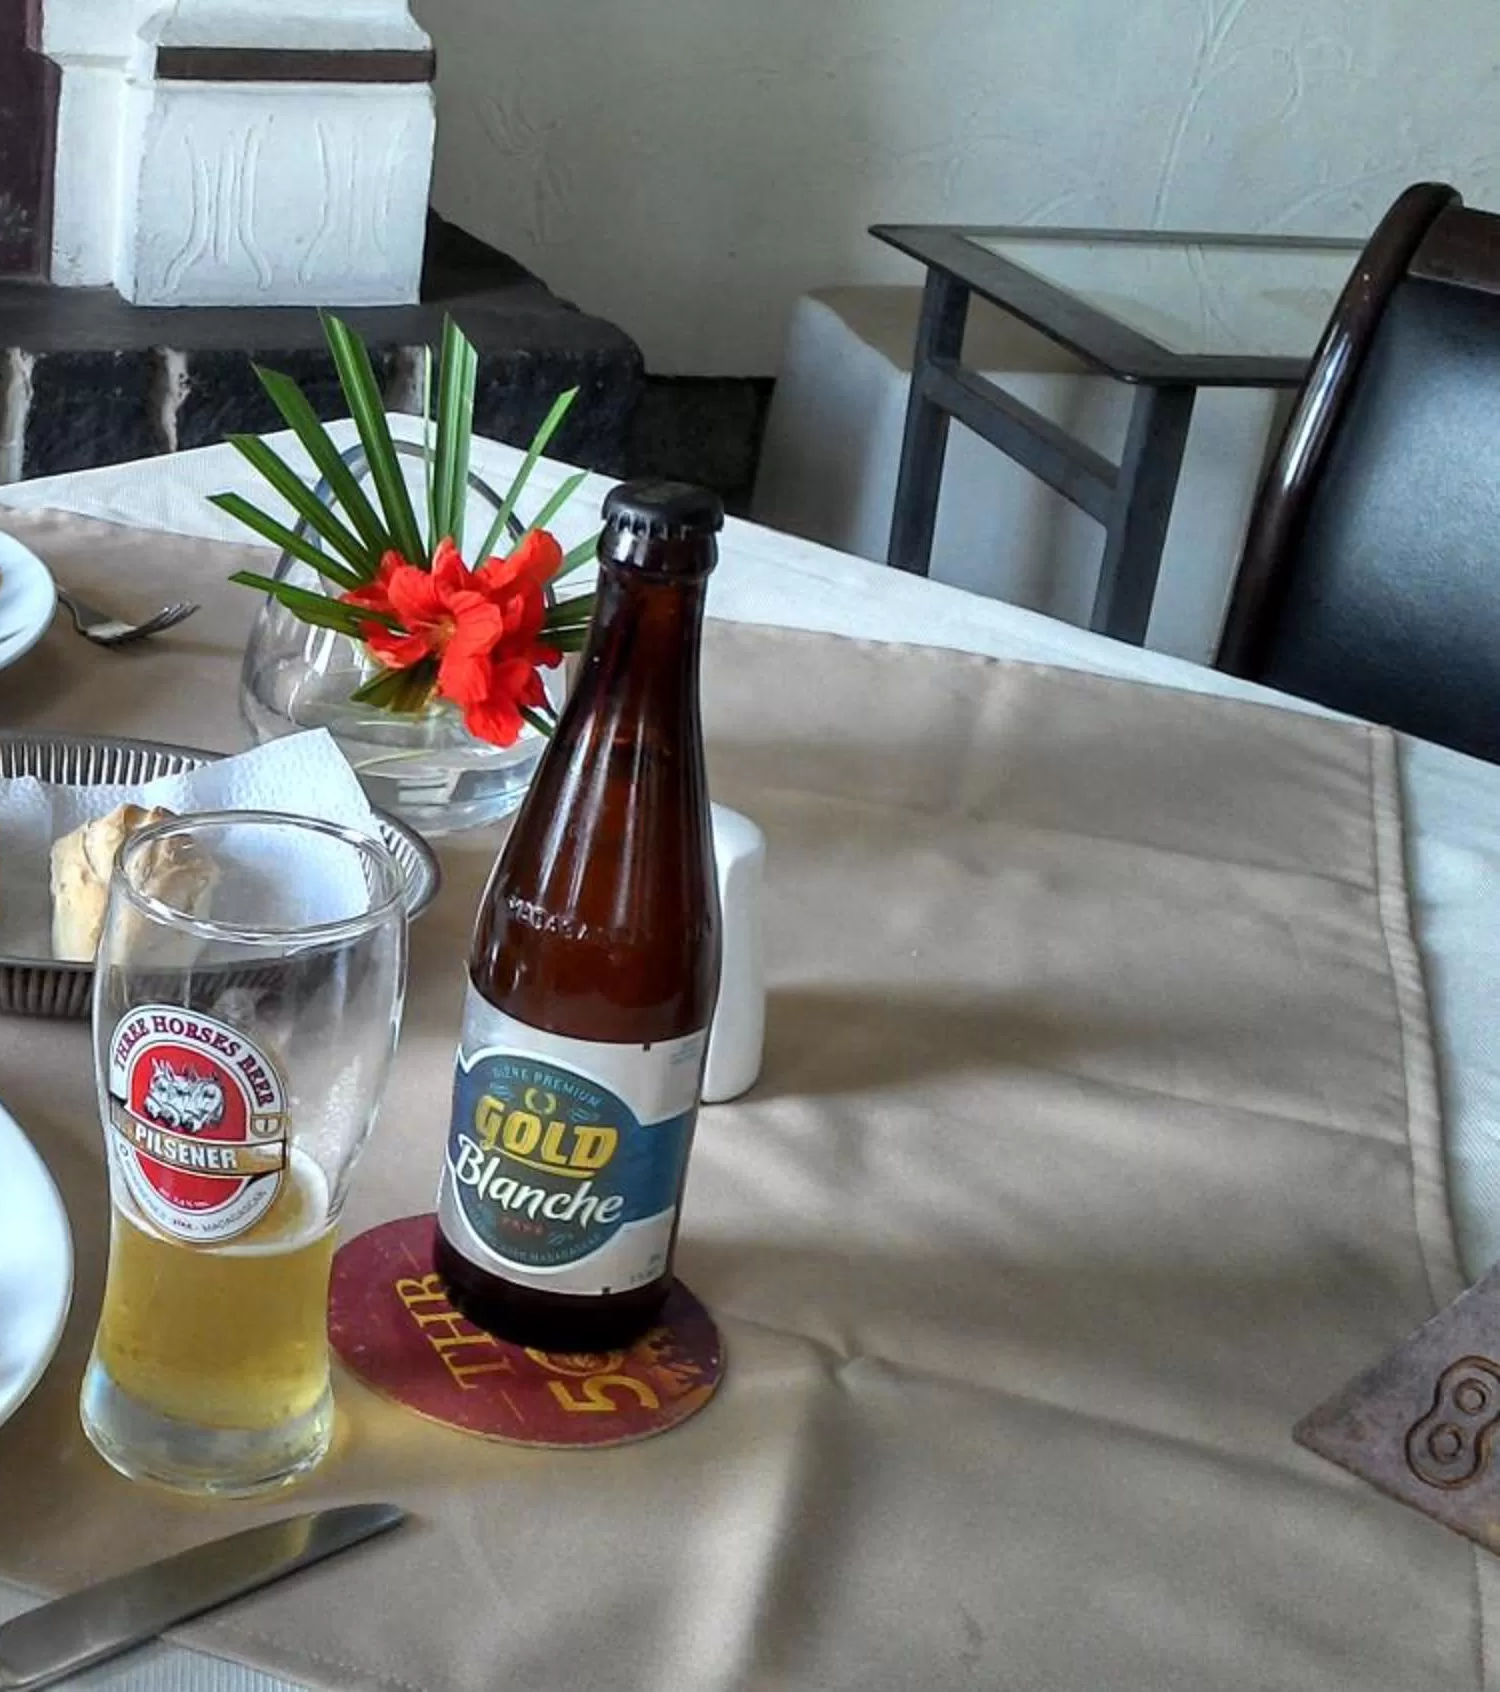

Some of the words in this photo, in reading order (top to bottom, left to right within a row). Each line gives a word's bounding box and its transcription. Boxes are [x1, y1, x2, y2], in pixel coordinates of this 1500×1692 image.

[114, 1017, 149, 1072] THREE
[151, 1015, 241, 1057] HORSES
[237, 1054, 275, 1108] BEER
[533, 1071, 603, 1107] PREMIUM
[135, 1123, 237, 1169] PILSENER
[475, 1094, 619, 1170] GOLD
[456, 1133, 624, 1229] Blanche
